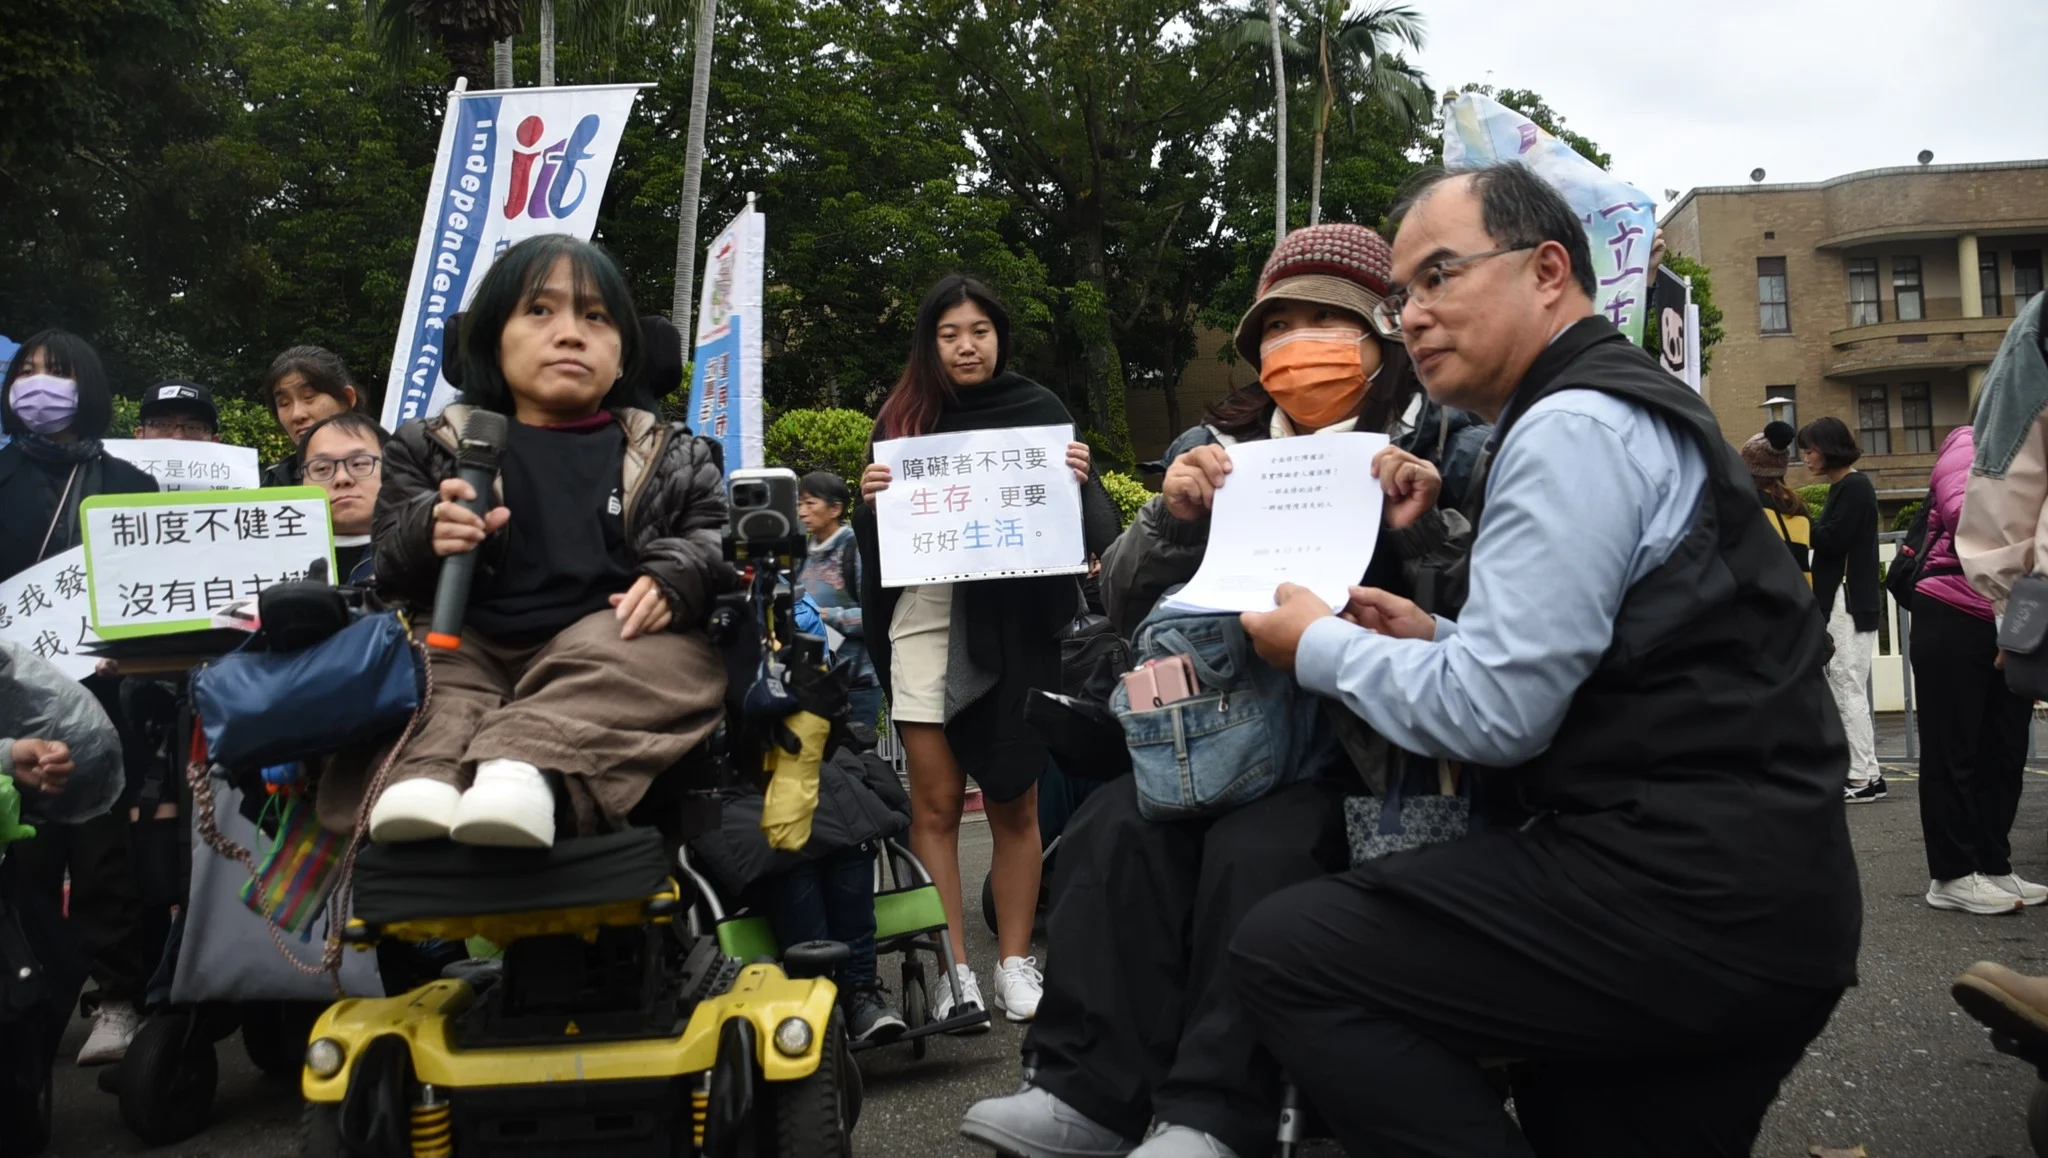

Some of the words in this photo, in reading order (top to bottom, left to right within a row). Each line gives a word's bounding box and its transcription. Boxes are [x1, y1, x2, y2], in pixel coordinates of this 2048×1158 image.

[425, 119, 493, 330] Independent
[402, 344, 439, 419] livin
[129, 459, 231, 480] 不是你的
[902, 447, 1048, 481] 障礙者不只要
[111, 505, 308, 547] 制度不健全
[118, 570, 311, 618] 沒有自主
